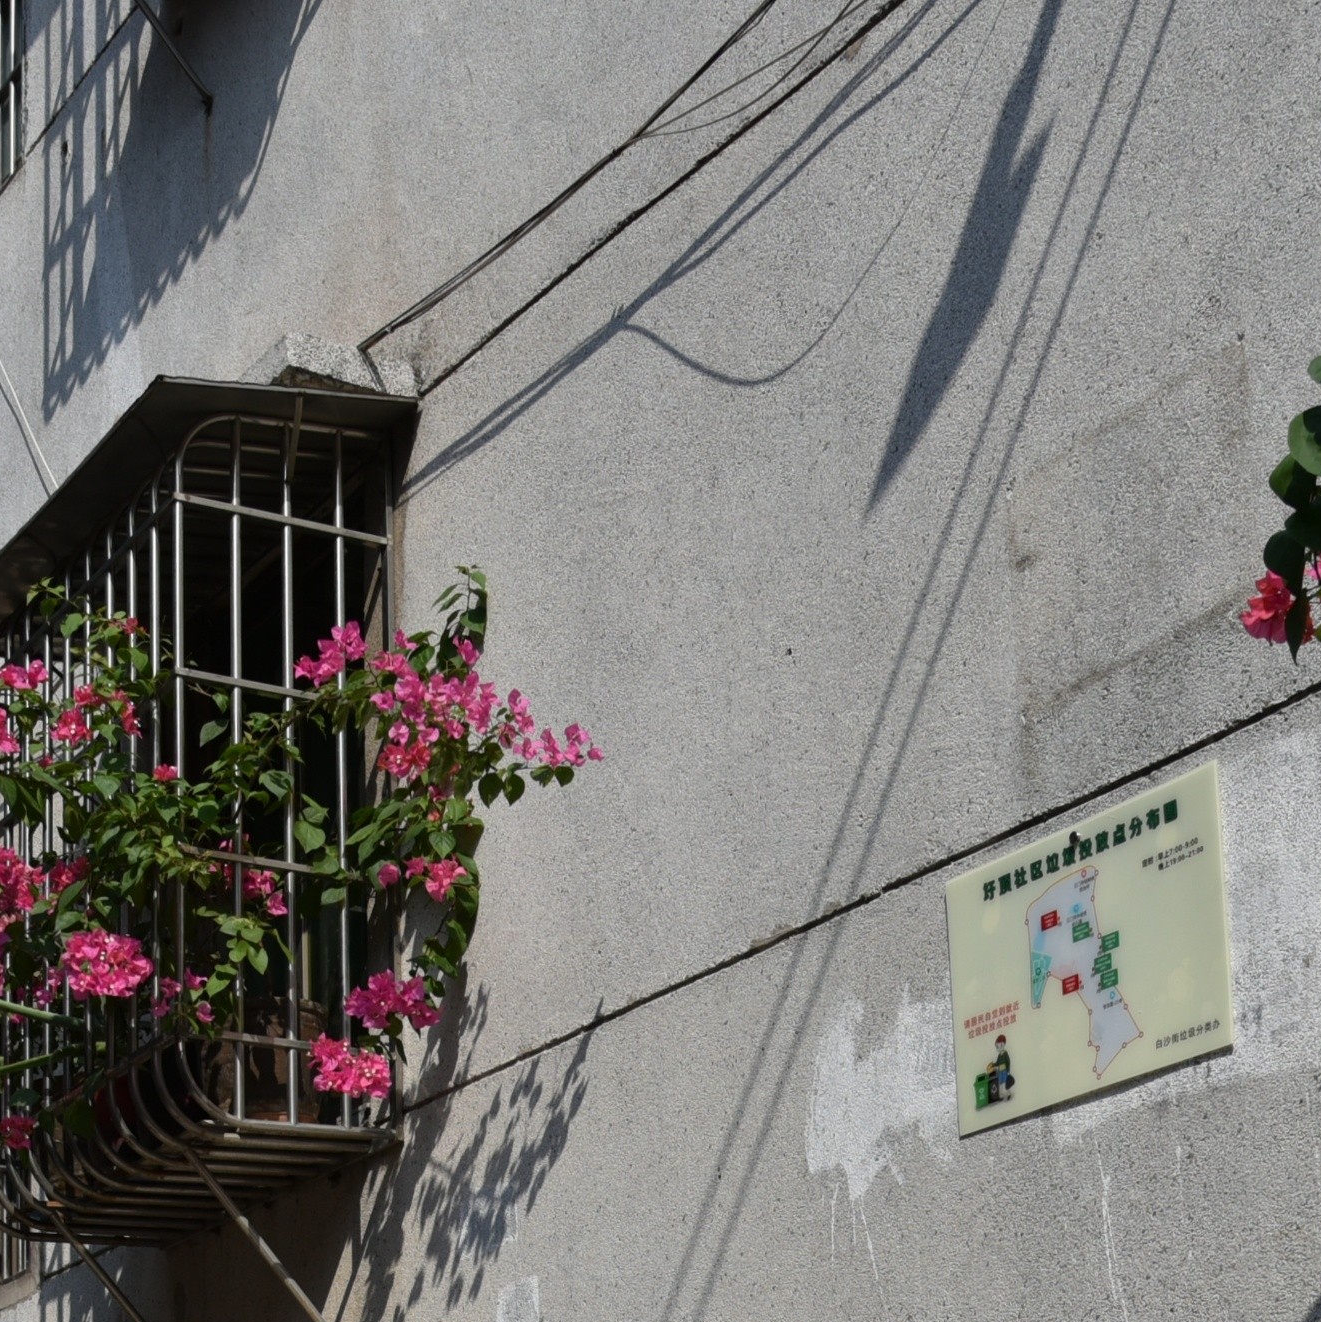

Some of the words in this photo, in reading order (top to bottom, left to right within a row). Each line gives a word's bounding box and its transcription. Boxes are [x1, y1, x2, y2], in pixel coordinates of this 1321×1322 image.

[964, 1000, 1019, 1029] 请居民自觉到就近
[968, 1013, 1017, 1038] 垃圾投放点投放
[1155, 1018, 1220, 1050] 白沙街垃圾分类办
